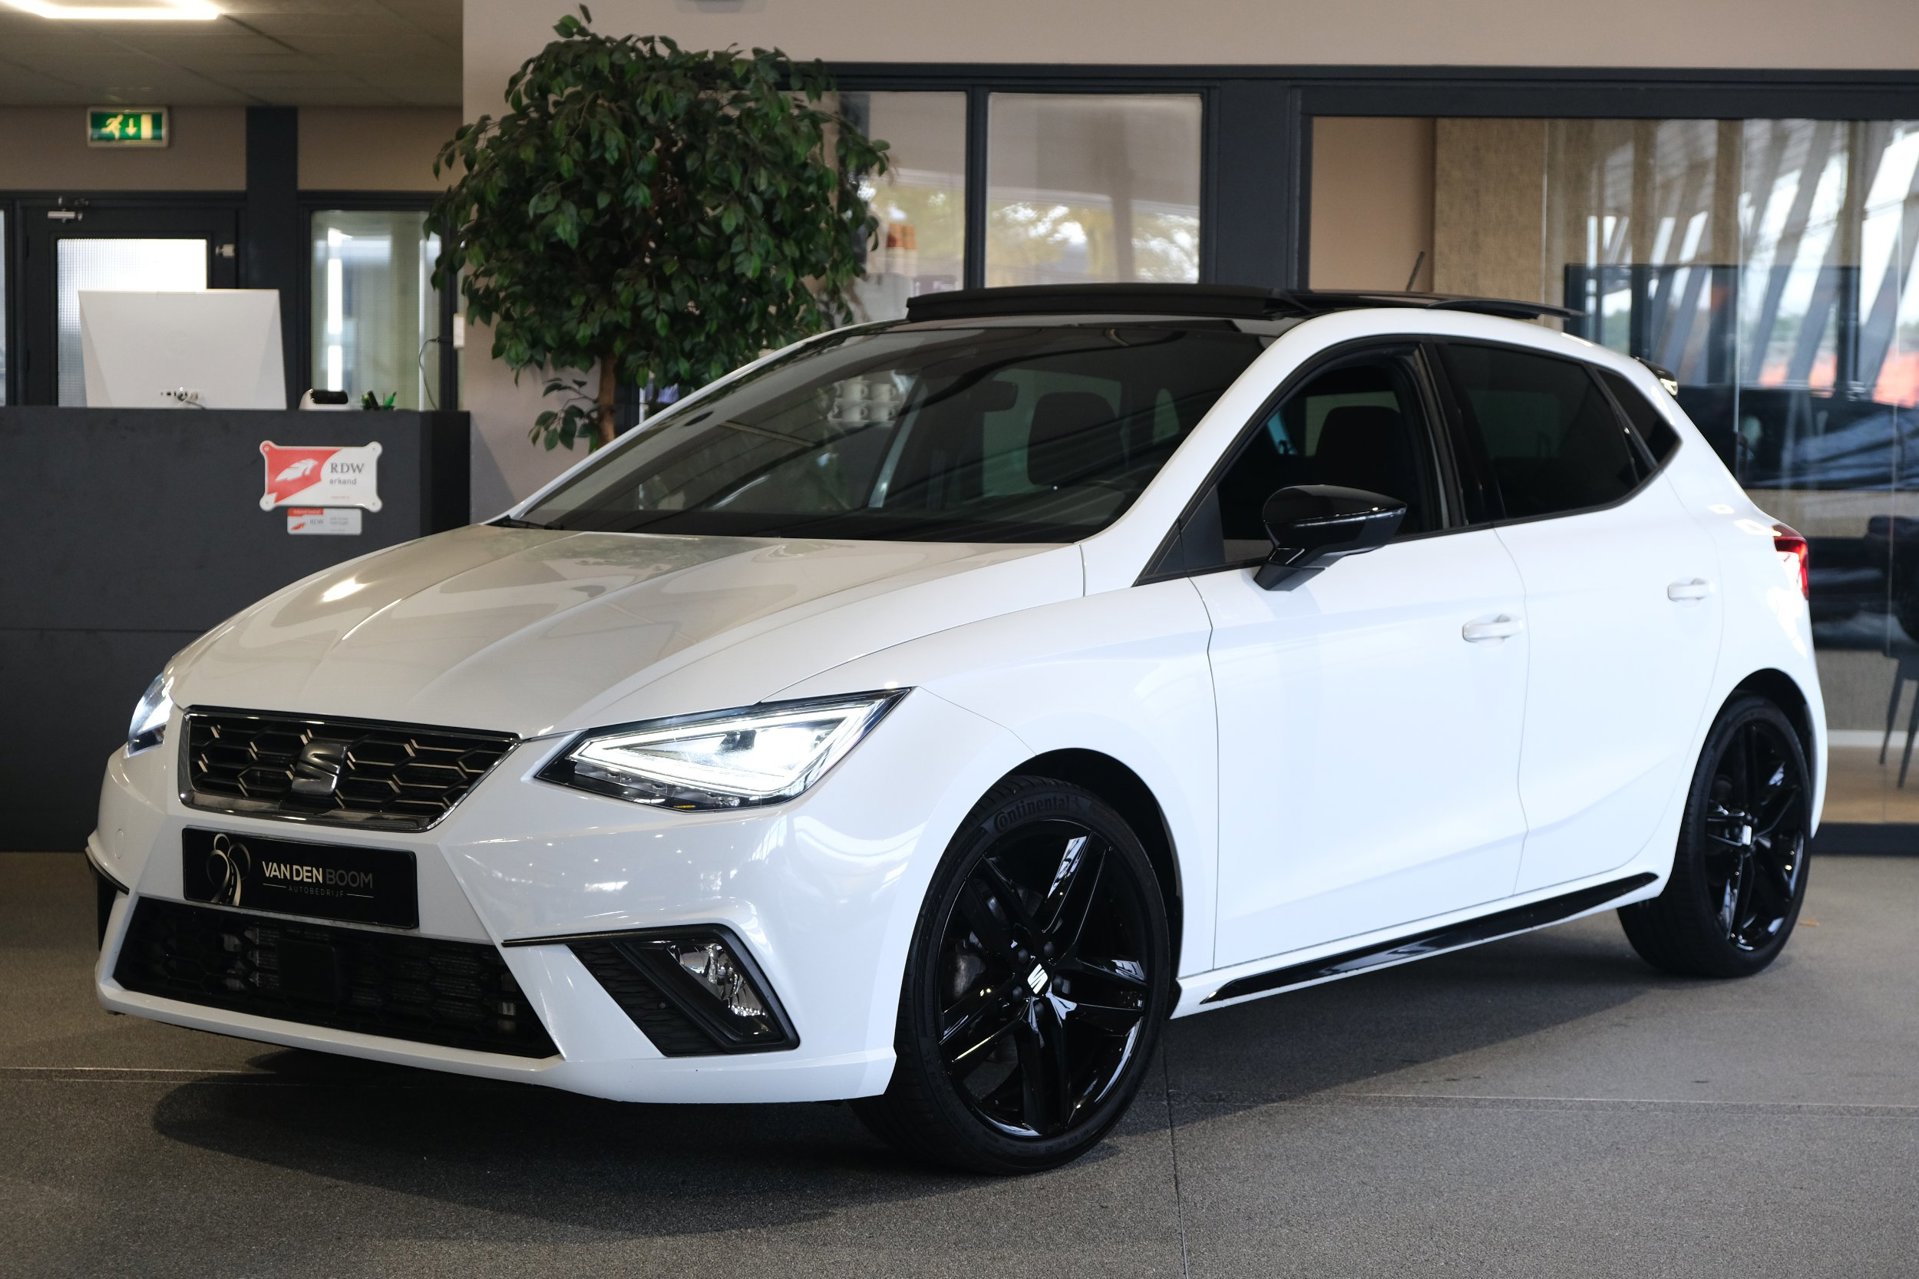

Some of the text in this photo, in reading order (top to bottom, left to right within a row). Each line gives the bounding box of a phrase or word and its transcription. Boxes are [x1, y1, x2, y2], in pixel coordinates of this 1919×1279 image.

[330, 462, 365, 474] RDW
[994, 796, 1070, 832] Continental
[262, 861, 373, 889] VAN DEN BOOM
[288, 885, 344, 897] AUTOBEDRIJF
